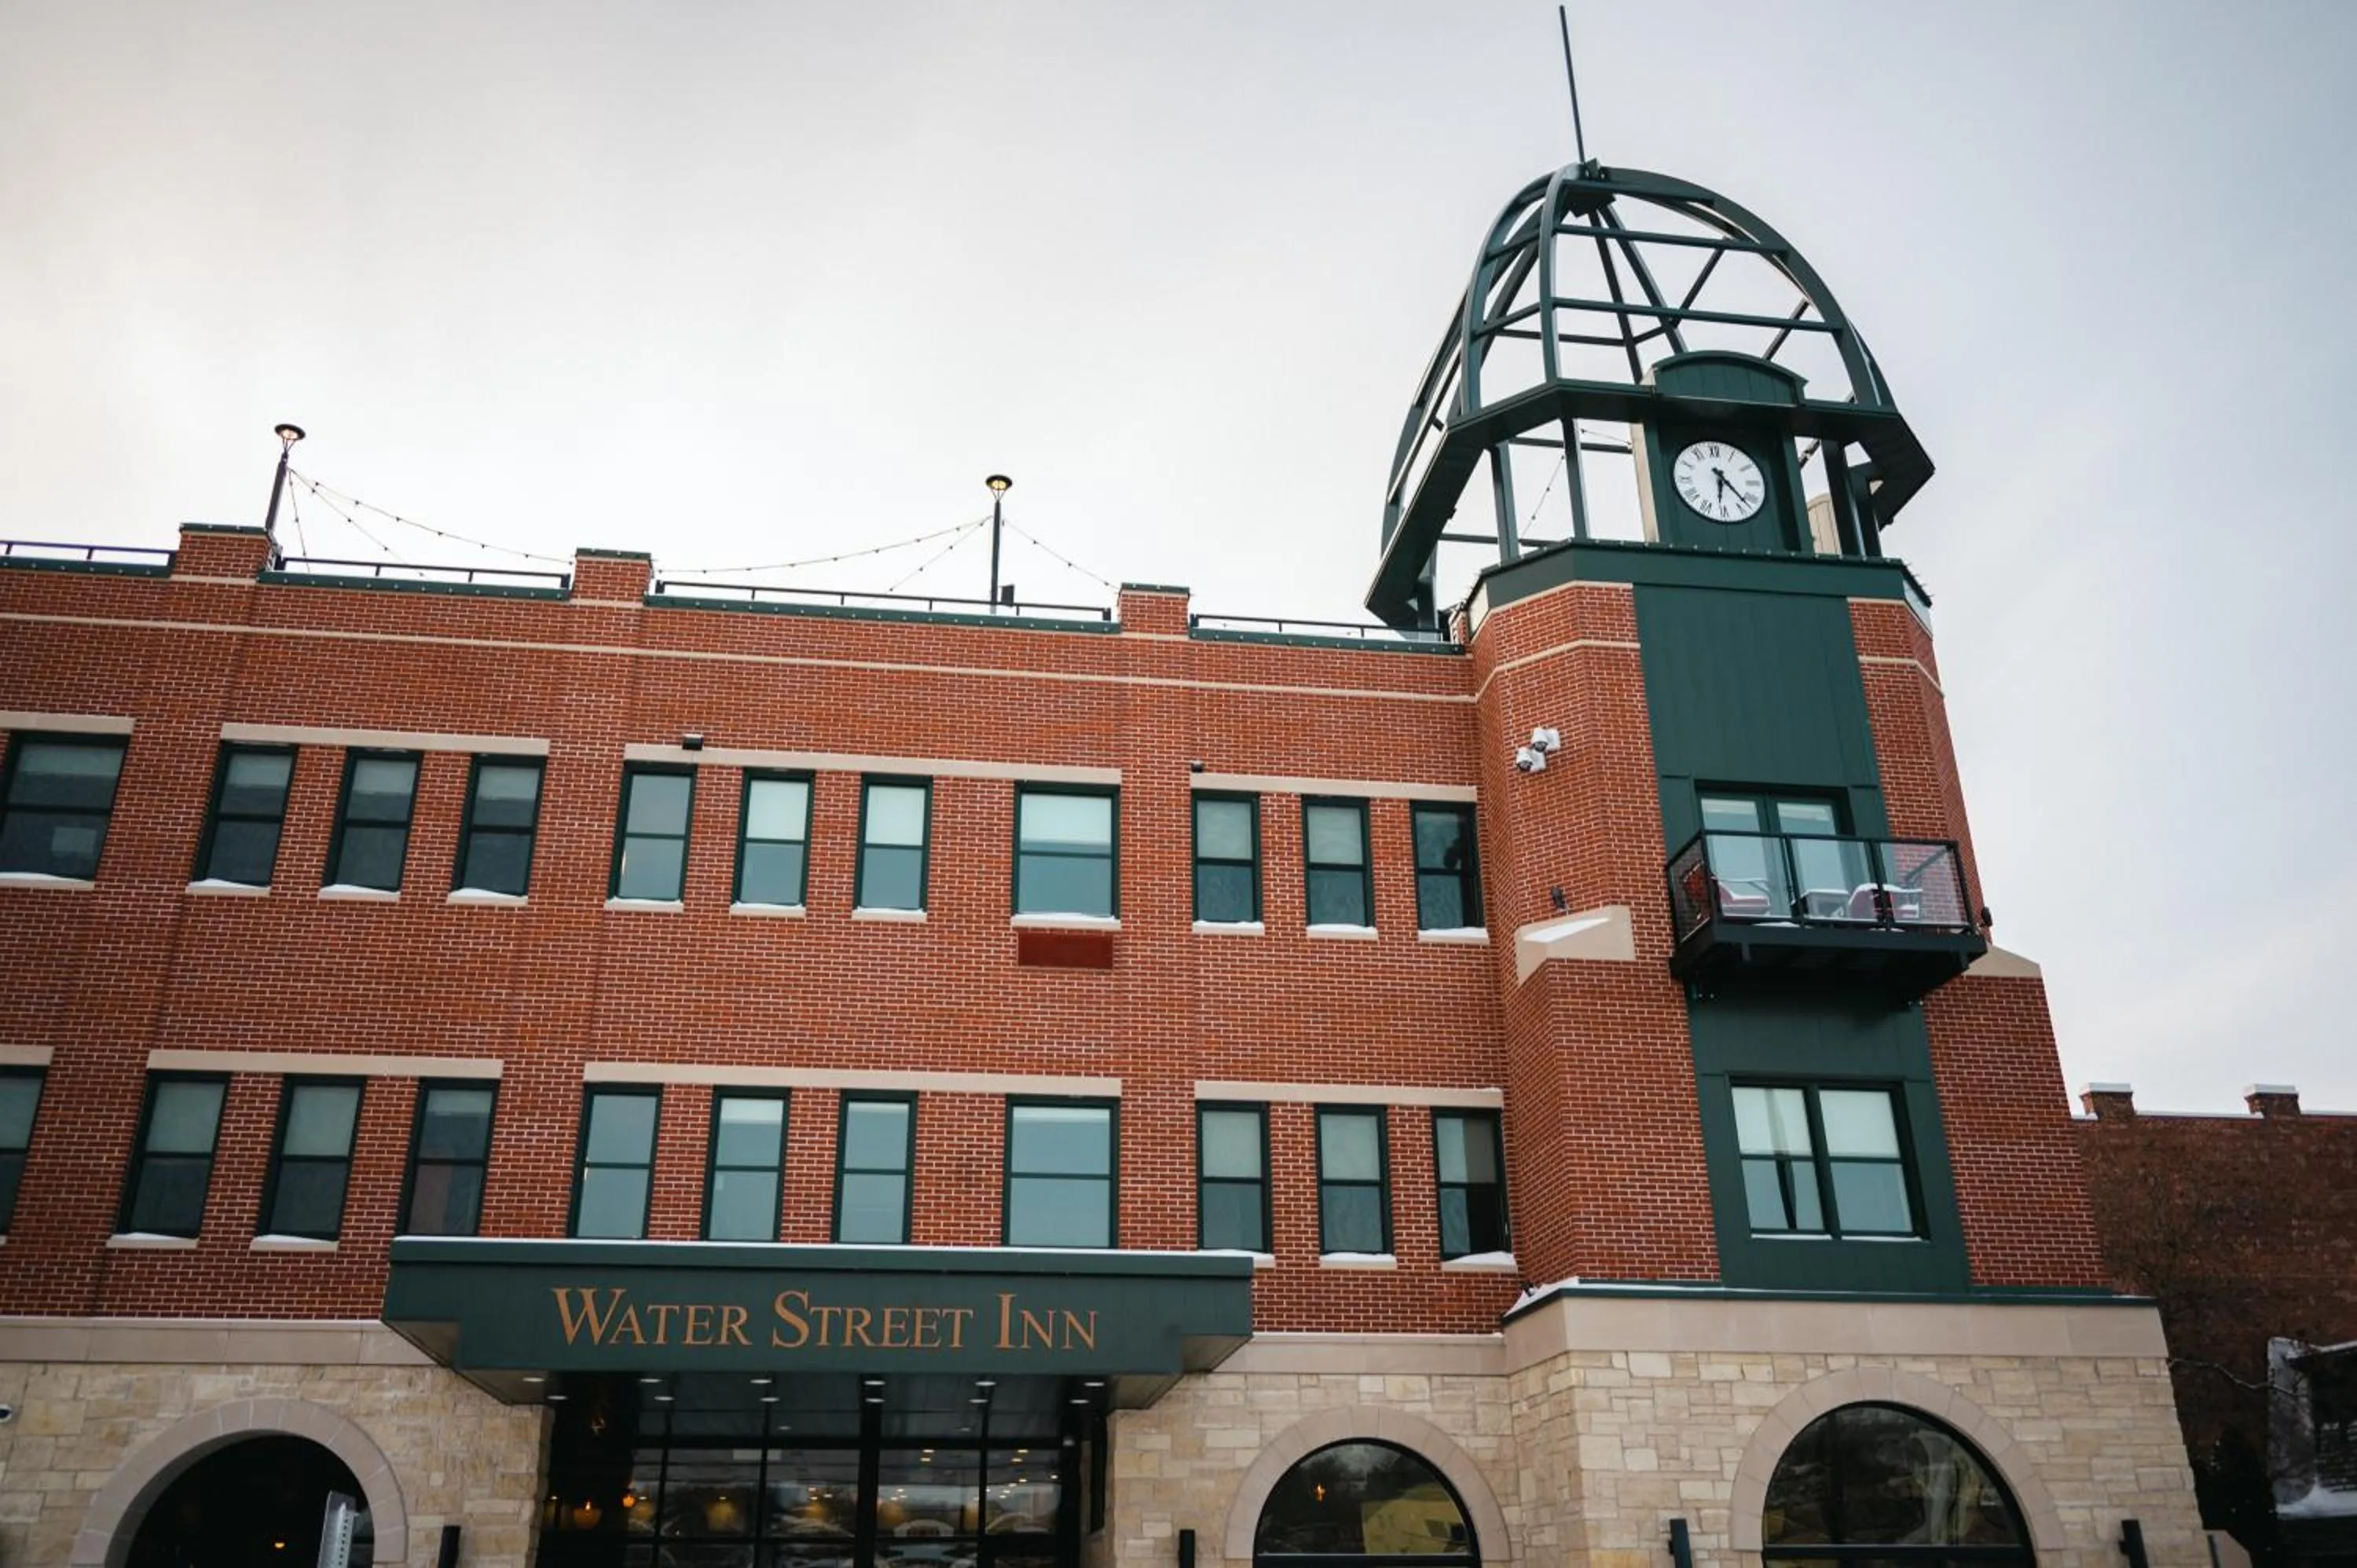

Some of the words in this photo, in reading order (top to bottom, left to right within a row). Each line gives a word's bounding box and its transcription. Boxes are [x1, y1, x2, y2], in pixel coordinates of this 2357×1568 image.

[552, 1288, 752, 1346] WATER
[772, 1291, 973, 1347] STREET
[993, 1294, 1098, 1349] INN
